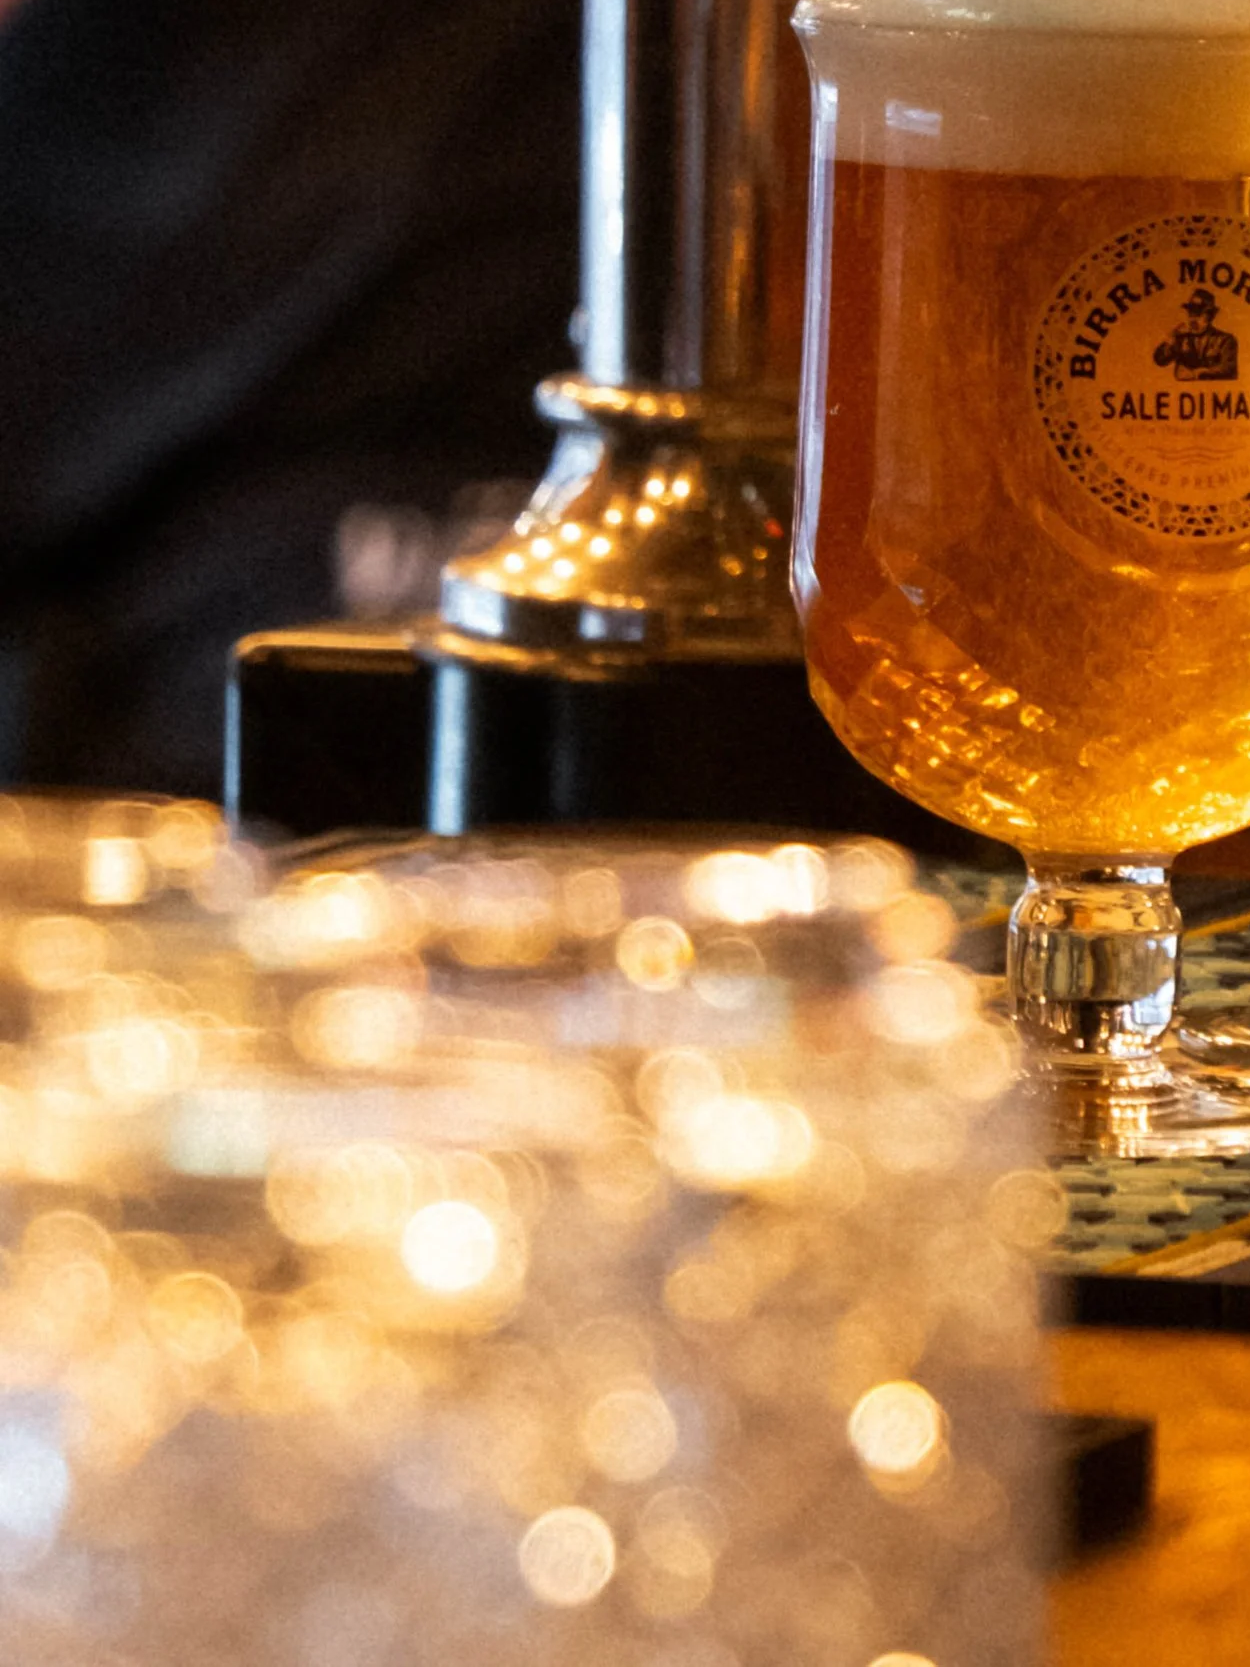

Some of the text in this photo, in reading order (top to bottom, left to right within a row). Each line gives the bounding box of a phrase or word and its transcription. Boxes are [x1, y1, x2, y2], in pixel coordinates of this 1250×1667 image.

[1070, 269, 1166, 380] BIRRA
[1101, 391, 1170, 421] SALE
[1179, 391, 1205, 421] DI
